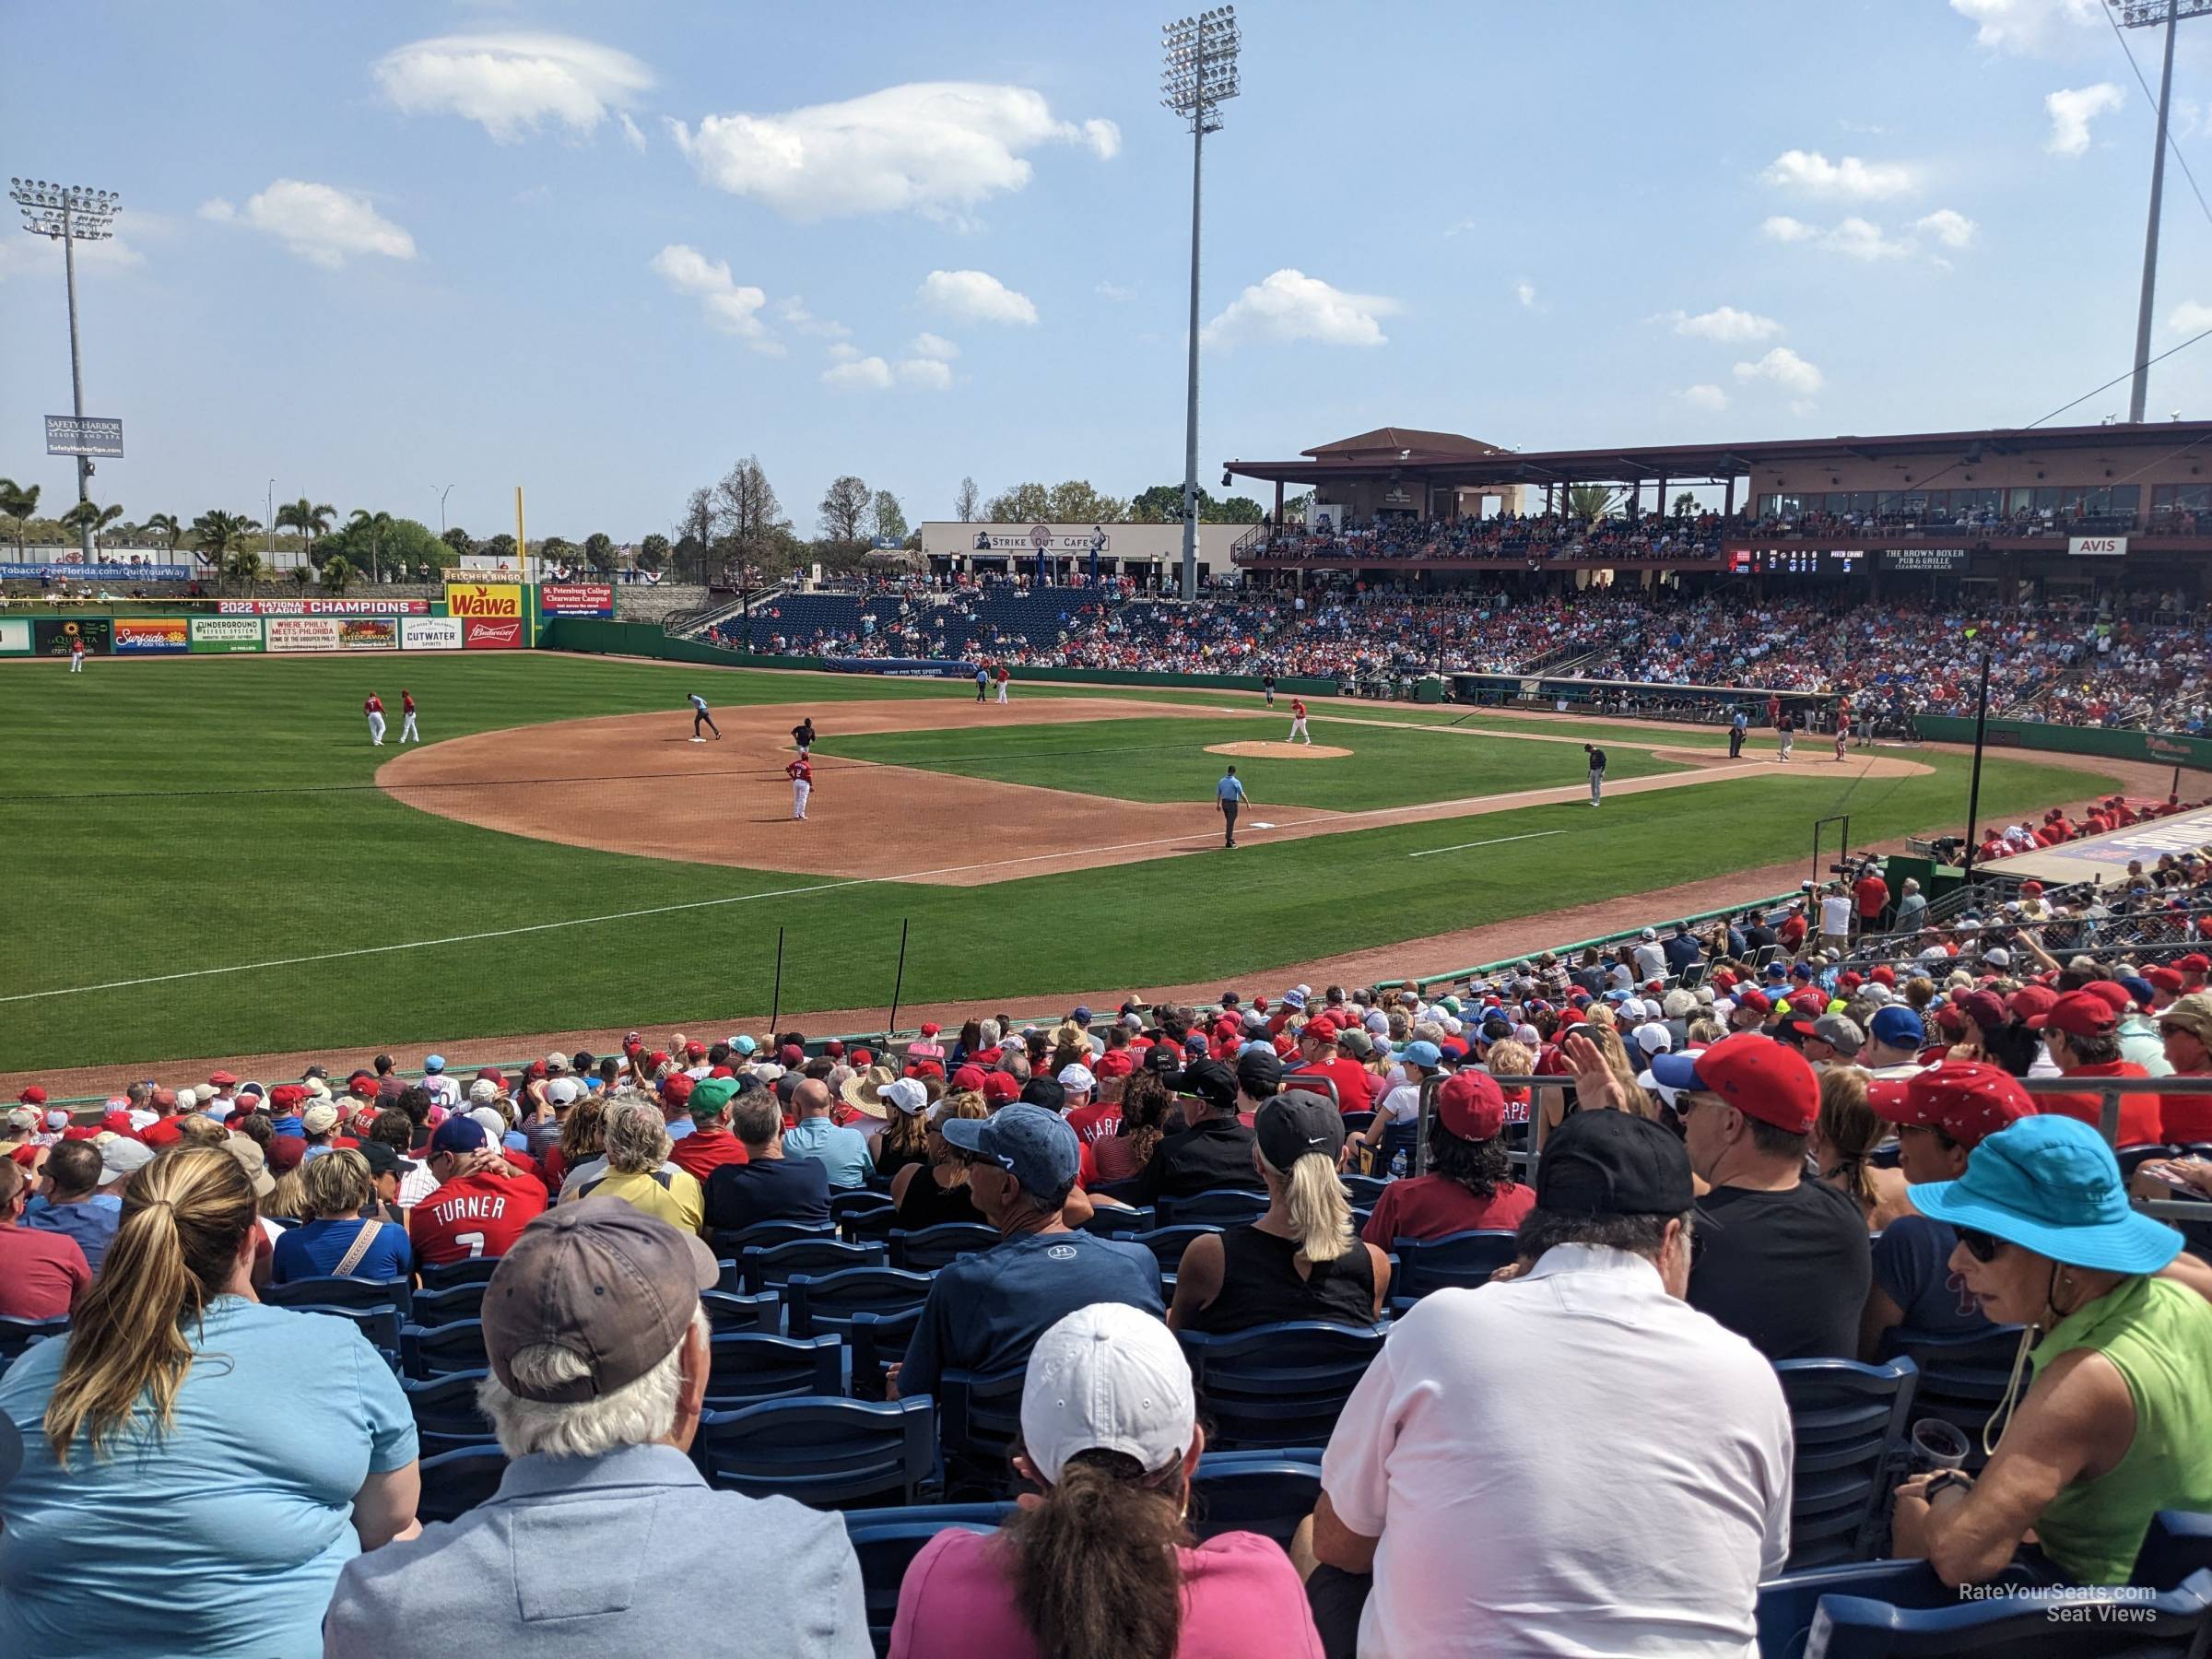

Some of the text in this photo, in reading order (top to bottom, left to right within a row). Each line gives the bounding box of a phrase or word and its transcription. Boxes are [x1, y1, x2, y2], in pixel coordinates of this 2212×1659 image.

[48, 419, 120, 430] SAFETY HARBOR
[49, 444, 122, 453] SafetyHarborSpa.com
[993, 537, 1026, 547] STRIKE
[1035, 537, 1055, 547] OUT
[2080, 541, 2115, 552] AVIS
[1843, 559, 1852, 572] 5
[2, 566, 185, 578] TobaccoreeFlorida.com/QuitYourWay
[444, 573, 521, 582] BELCHER BINGO
[553, 587, 586, 595] Petersburg
[587, 587, 611, 595] College
[582, 594, 607, 603] Campus
[221, 603, 253, 613] 2022
[311, 602, 410, 613] CHAMPIONS
[452, 594, 516, 616] Wawa
[202, 621, 257, 629] UNDERGROUND
[299, 628, 335, 636] PHLORIDA
[407, 631, 455, 641] CUTWATER
[473, 627, 514, 637] Budweiser
[116, 629, 172, 646] Surfside
[432, 1196, 506, 1227] TURNER
[455, 1231, 485, 1258] 7
